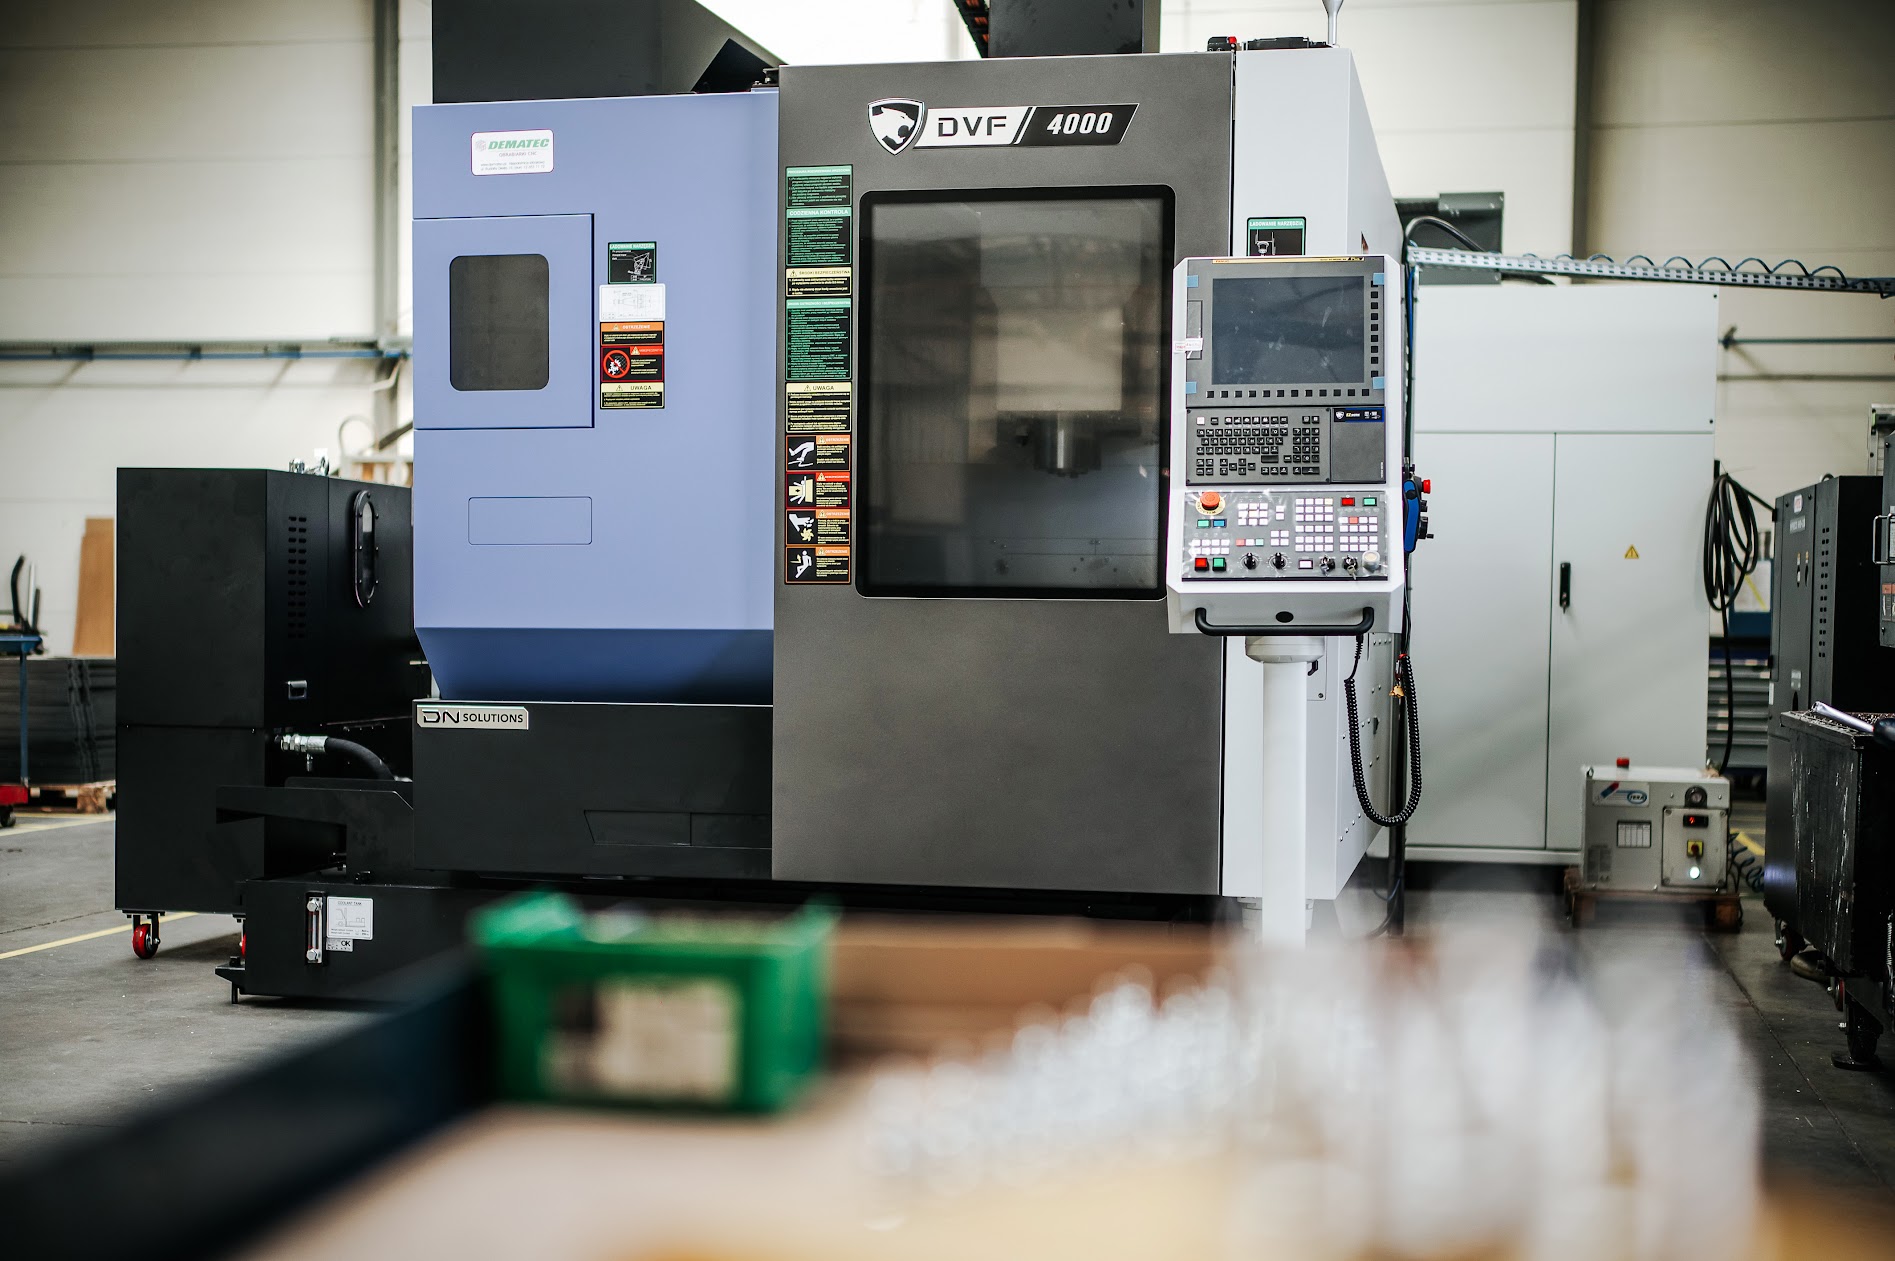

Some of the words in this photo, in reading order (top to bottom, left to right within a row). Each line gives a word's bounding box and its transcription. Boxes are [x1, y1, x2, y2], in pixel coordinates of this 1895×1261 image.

[938, 115, 1007, 137] DVF
[1047, 112, 1113, 135] 4000
[488, 139, 549, 150] DEMATEC
[422, 709, 460, 724] DN
[463, 713, 523, 723] SOLUTIONS
